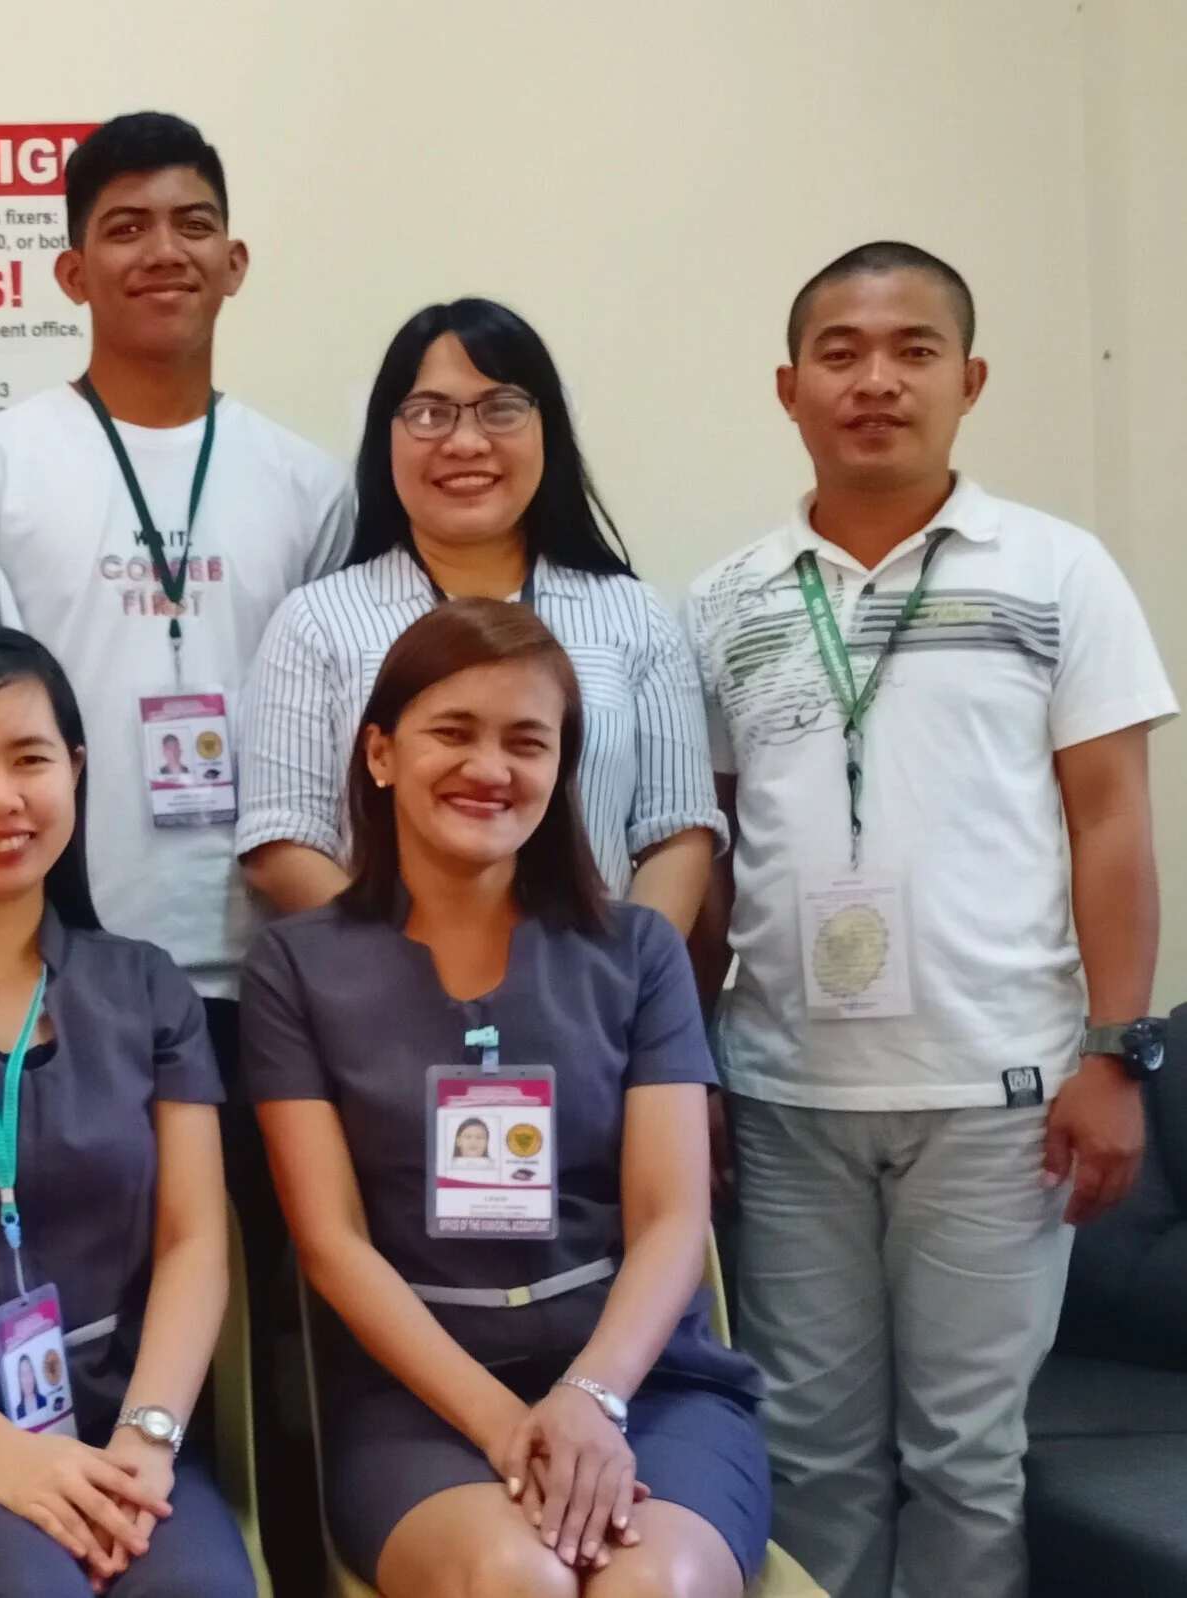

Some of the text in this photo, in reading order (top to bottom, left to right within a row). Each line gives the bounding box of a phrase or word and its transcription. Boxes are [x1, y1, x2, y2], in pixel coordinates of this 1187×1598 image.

[5, 208, 58, 225] fixers:
[17, 237, 34, 250] or
[39, 233, 70, 250] bot
[32, 320, 84, 338] office,
